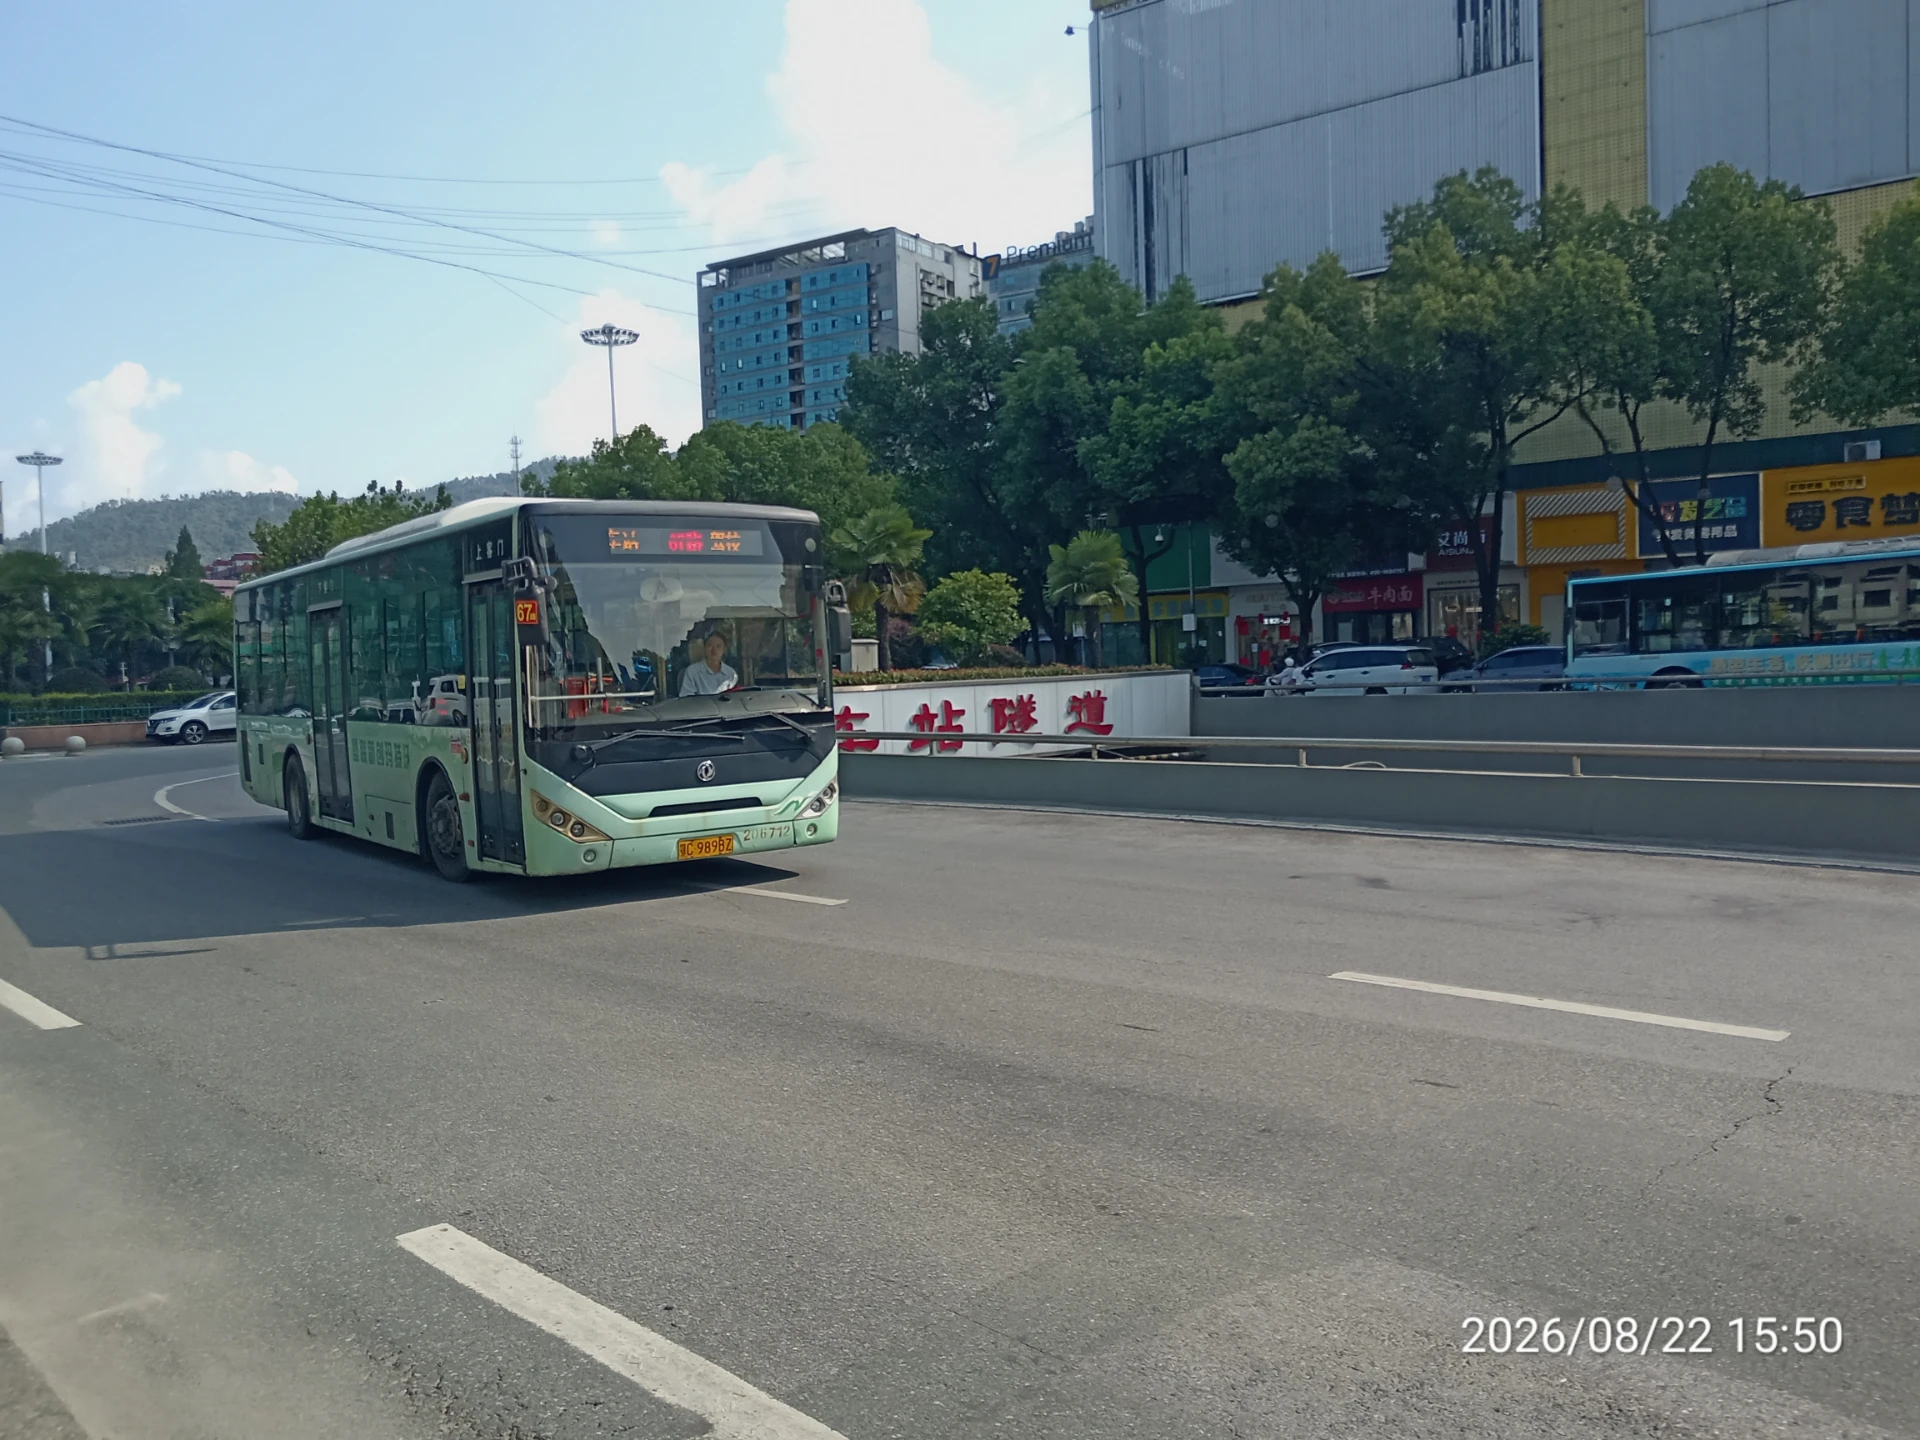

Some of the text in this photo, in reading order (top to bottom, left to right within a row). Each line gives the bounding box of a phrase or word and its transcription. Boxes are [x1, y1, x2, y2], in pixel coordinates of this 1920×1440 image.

[1006, 233, 1093, 264] Premium
[476, 539, 504, 561] 上客门
[743, 825, 790, 841] 206712
